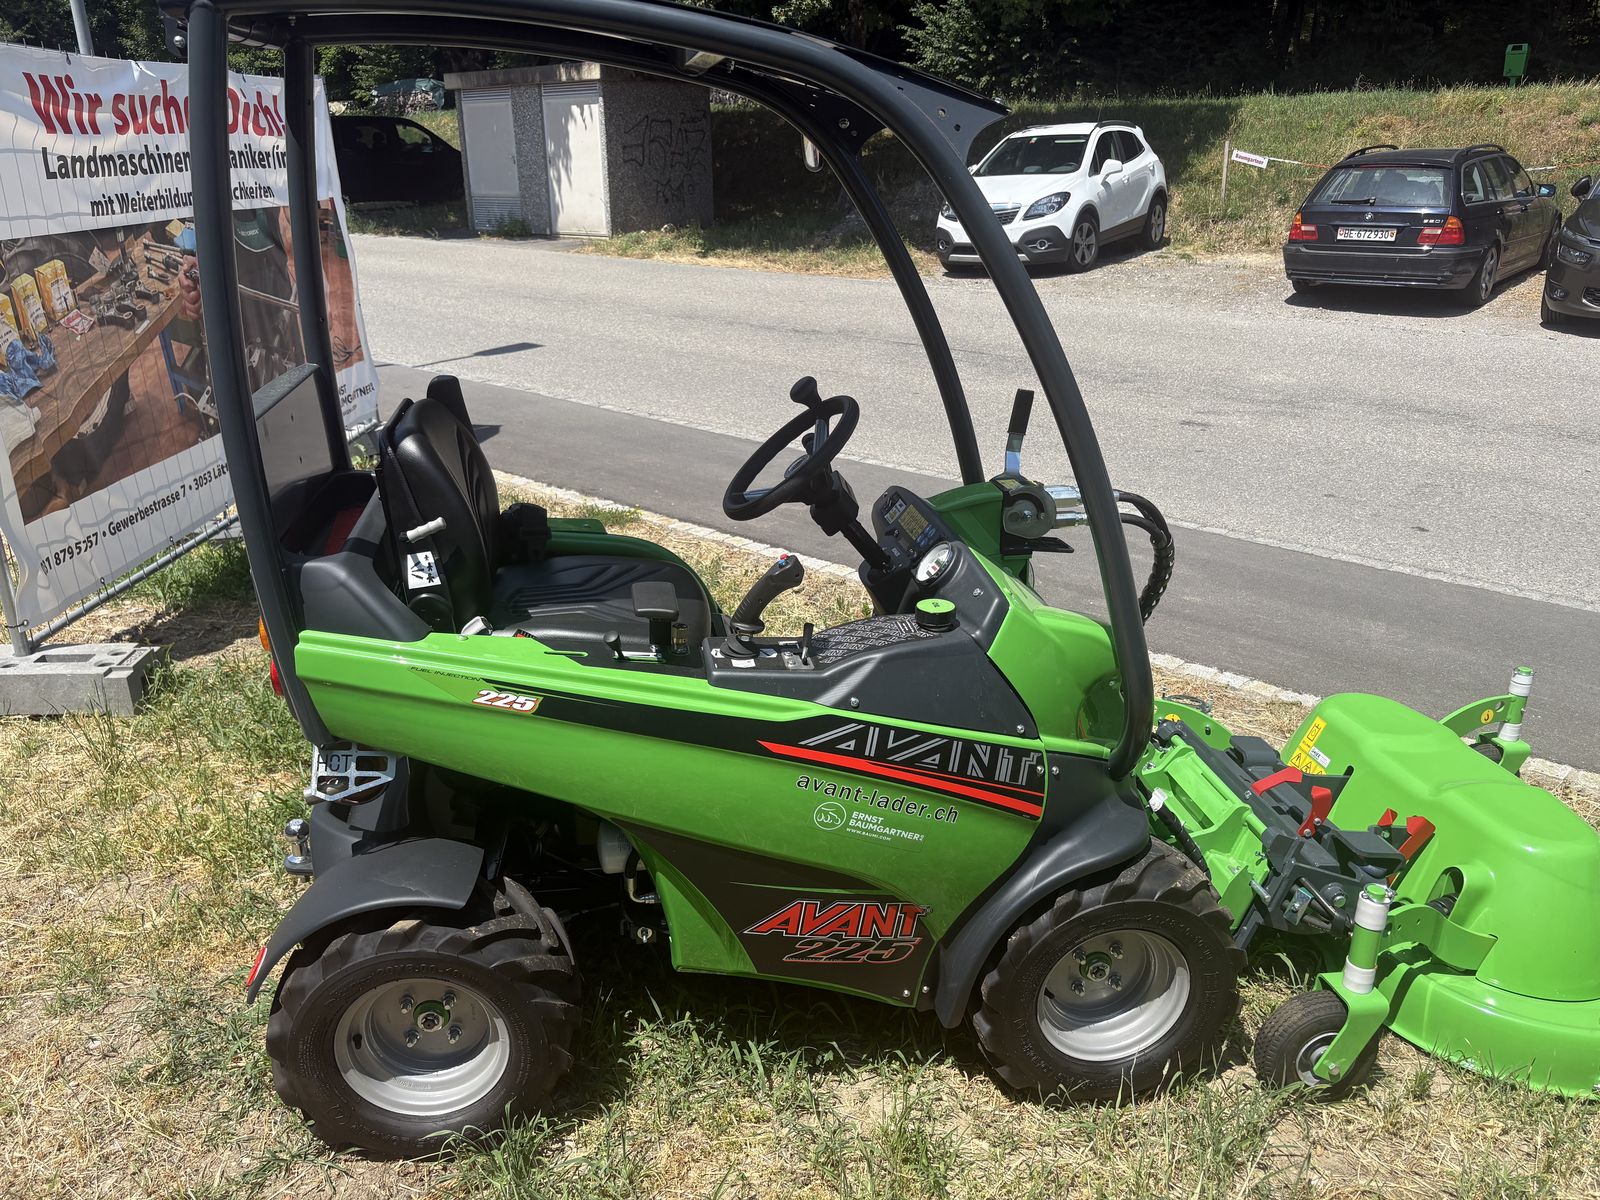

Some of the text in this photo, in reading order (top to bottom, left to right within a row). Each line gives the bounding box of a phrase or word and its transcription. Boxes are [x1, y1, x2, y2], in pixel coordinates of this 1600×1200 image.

[22, 72, 102, 135] Wir
[112, 79, 190, 136] such
[90, 195, 116, 217] mit
[53, 545, 74, 566] 879
[108, 489, 181, 536] Gewerbestrasse
[180, 483, 186, 498] 7
[193, 470, 212, 490] 3053
[410, 666, 481, 682] FUEL INJECTION
[472, 689, 539, 714] 225
[798, 722, 1043, 787] AVANT
[796, 772, 959, 824] avant-lader.ch
[852, 811, 884, 825] ERNST
[846, 828, 891, 841] WWW.BAUMI.COM
[743, 899, 926, 938] AVANT
[783, 937, 924, 964] 225
